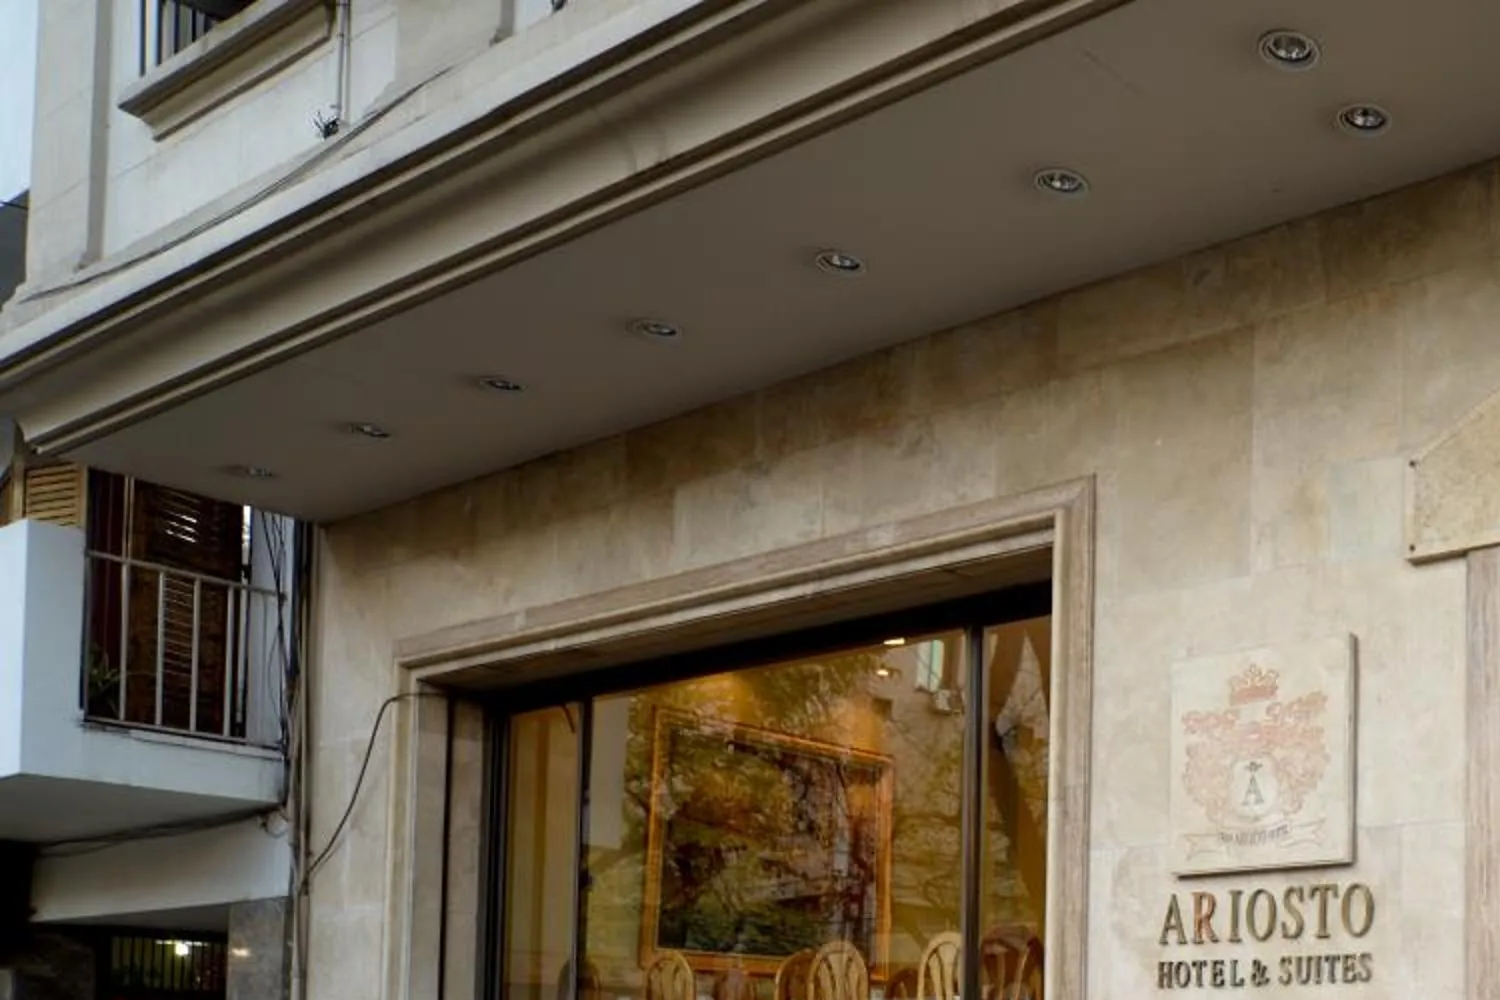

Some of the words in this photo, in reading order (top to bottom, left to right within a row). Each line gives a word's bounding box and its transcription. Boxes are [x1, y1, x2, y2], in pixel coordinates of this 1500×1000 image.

[1242, 773, 1265, 807] A
[1159, 883, 1375, 945] ARIOSTO
[1157, 959, 1245, 989] HOTEL
[1251, 957, 1270, 987] &
[1278, 952, 1373, 986] SUITES
